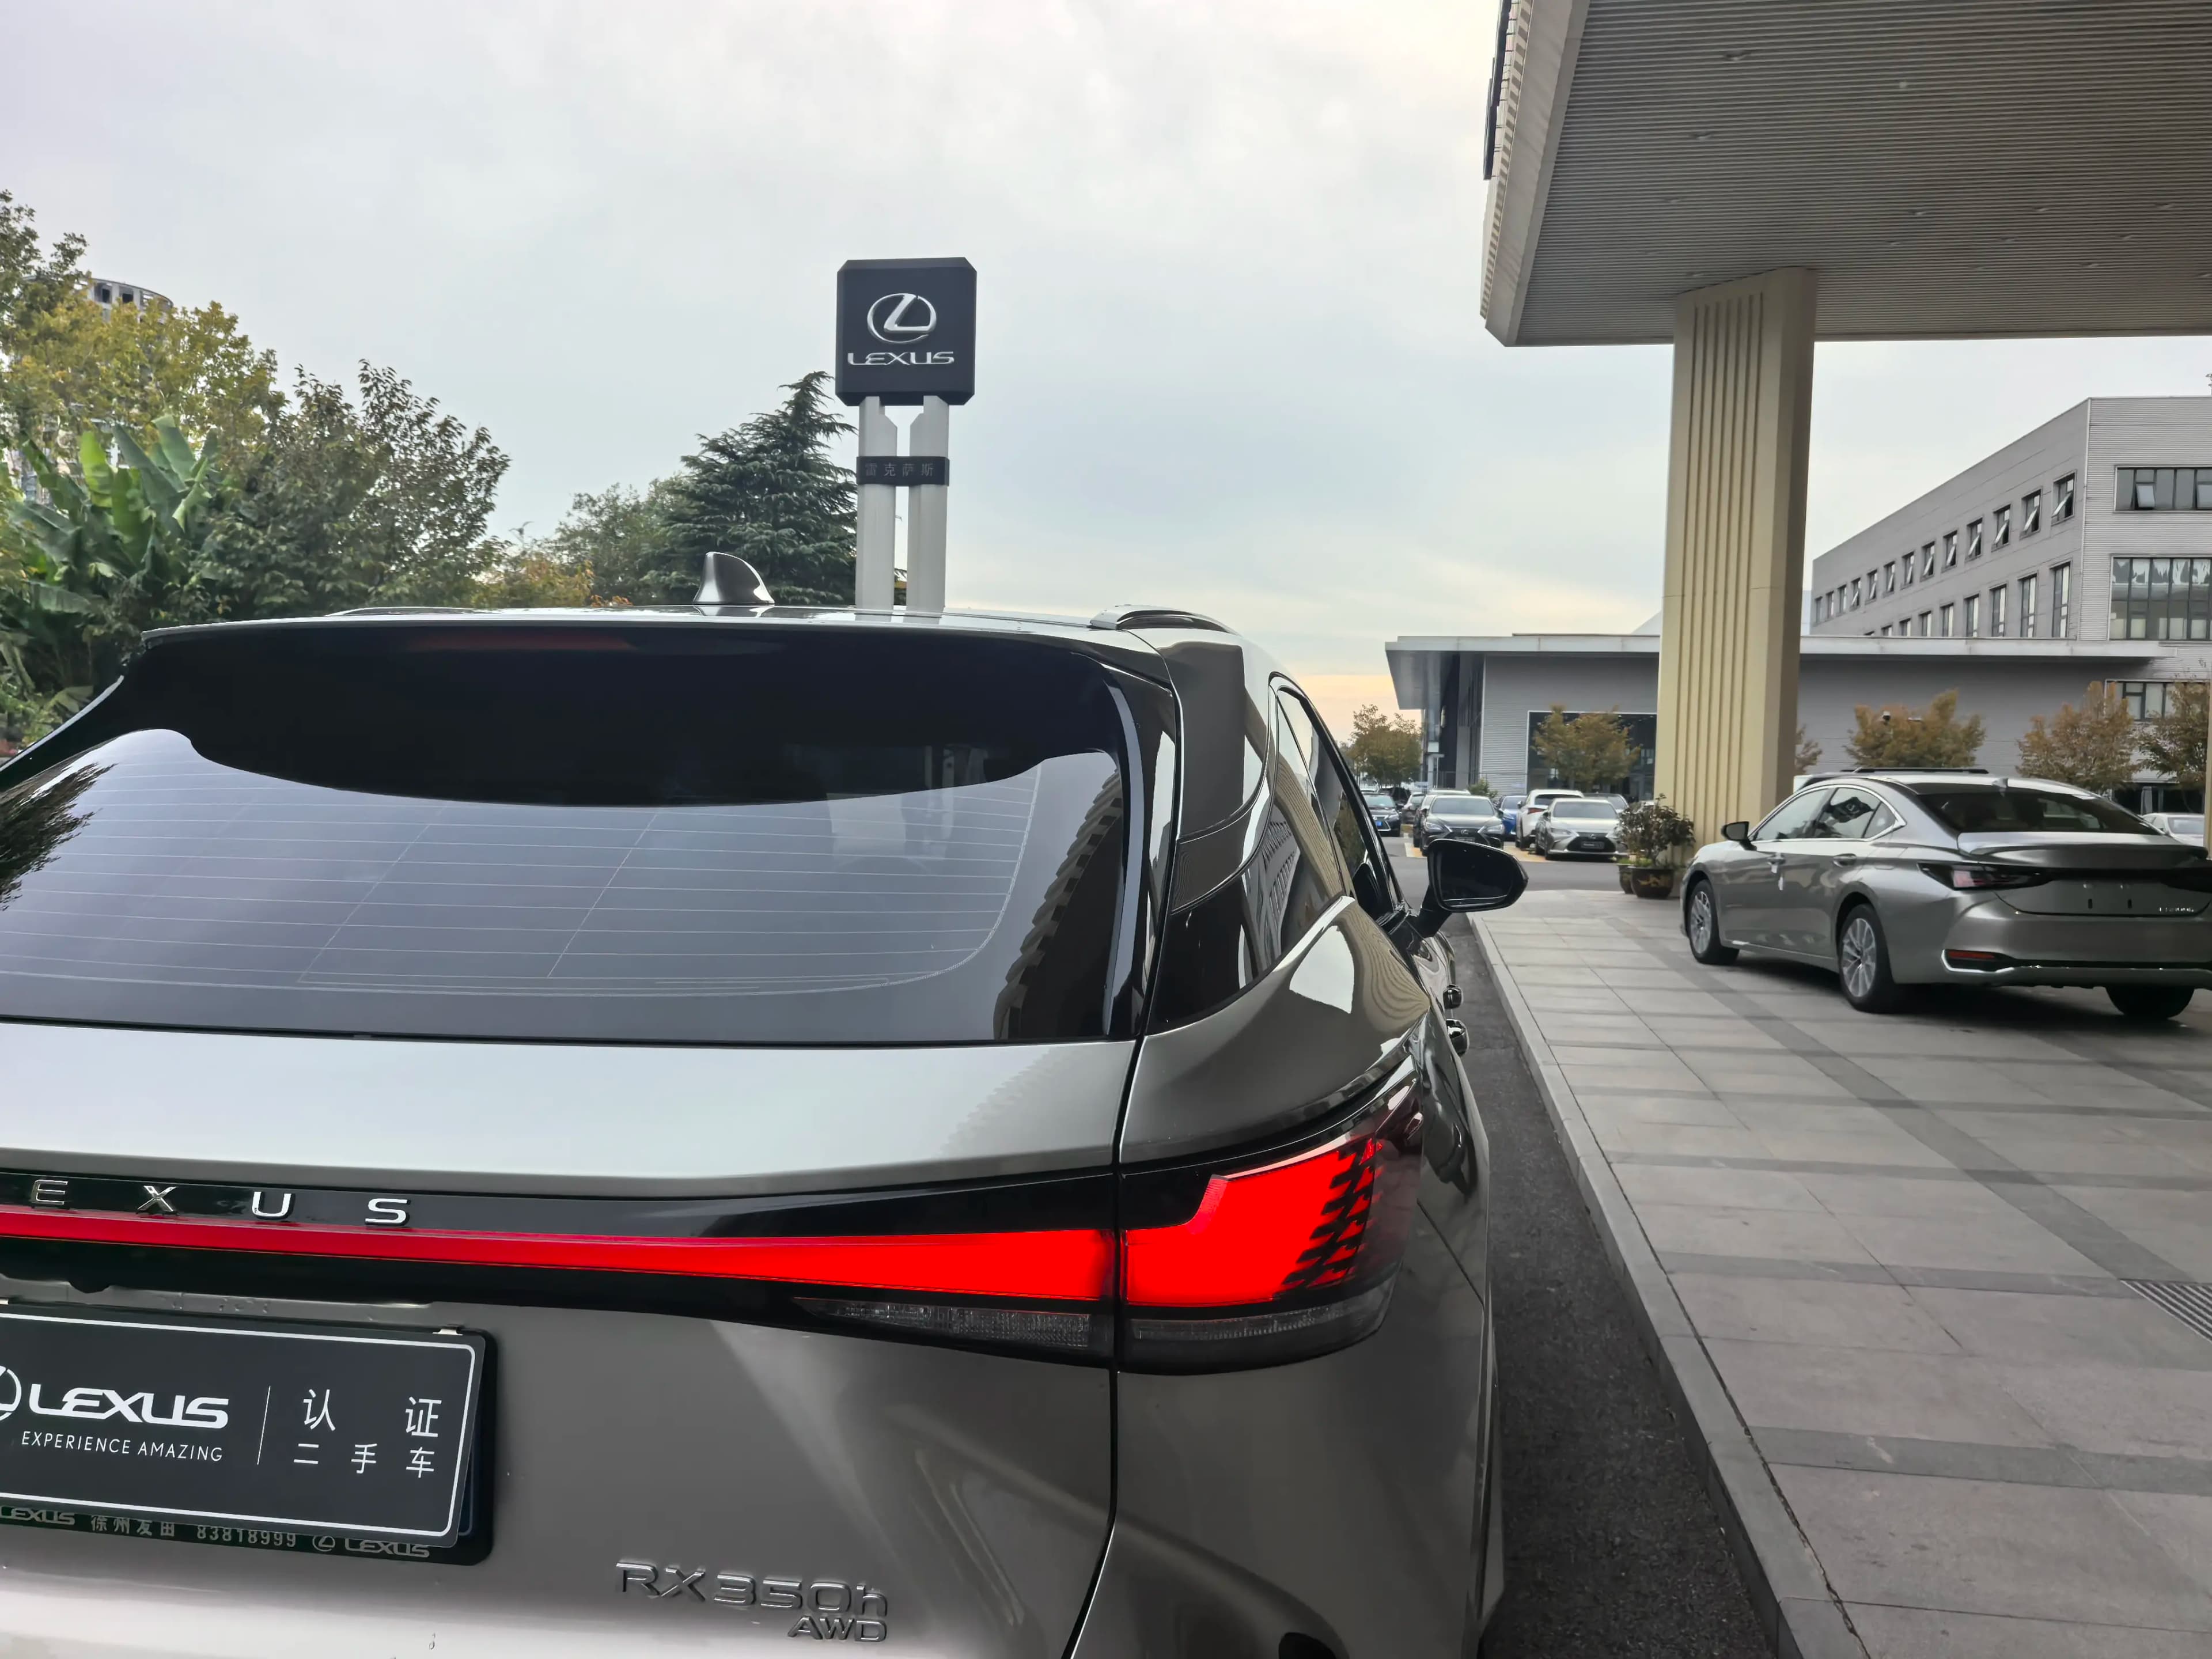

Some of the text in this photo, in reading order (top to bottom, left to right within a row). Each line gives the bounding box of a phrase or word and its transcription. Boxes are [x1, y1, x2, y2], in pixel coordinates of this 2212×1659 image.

[847, 351, 955, 365] LEXUS
[865, 463, 934, 476] 雷克萨斯
[29, 1383, 229, 1429] LEXUS
[21, 1430, 222, 1461] EXPERIENCE AMAZING
[0, 1505, 430, 1558] LEXUS 徐州友田 83818999 LEXUS
[787, 1615, 888, 1642] AWD
